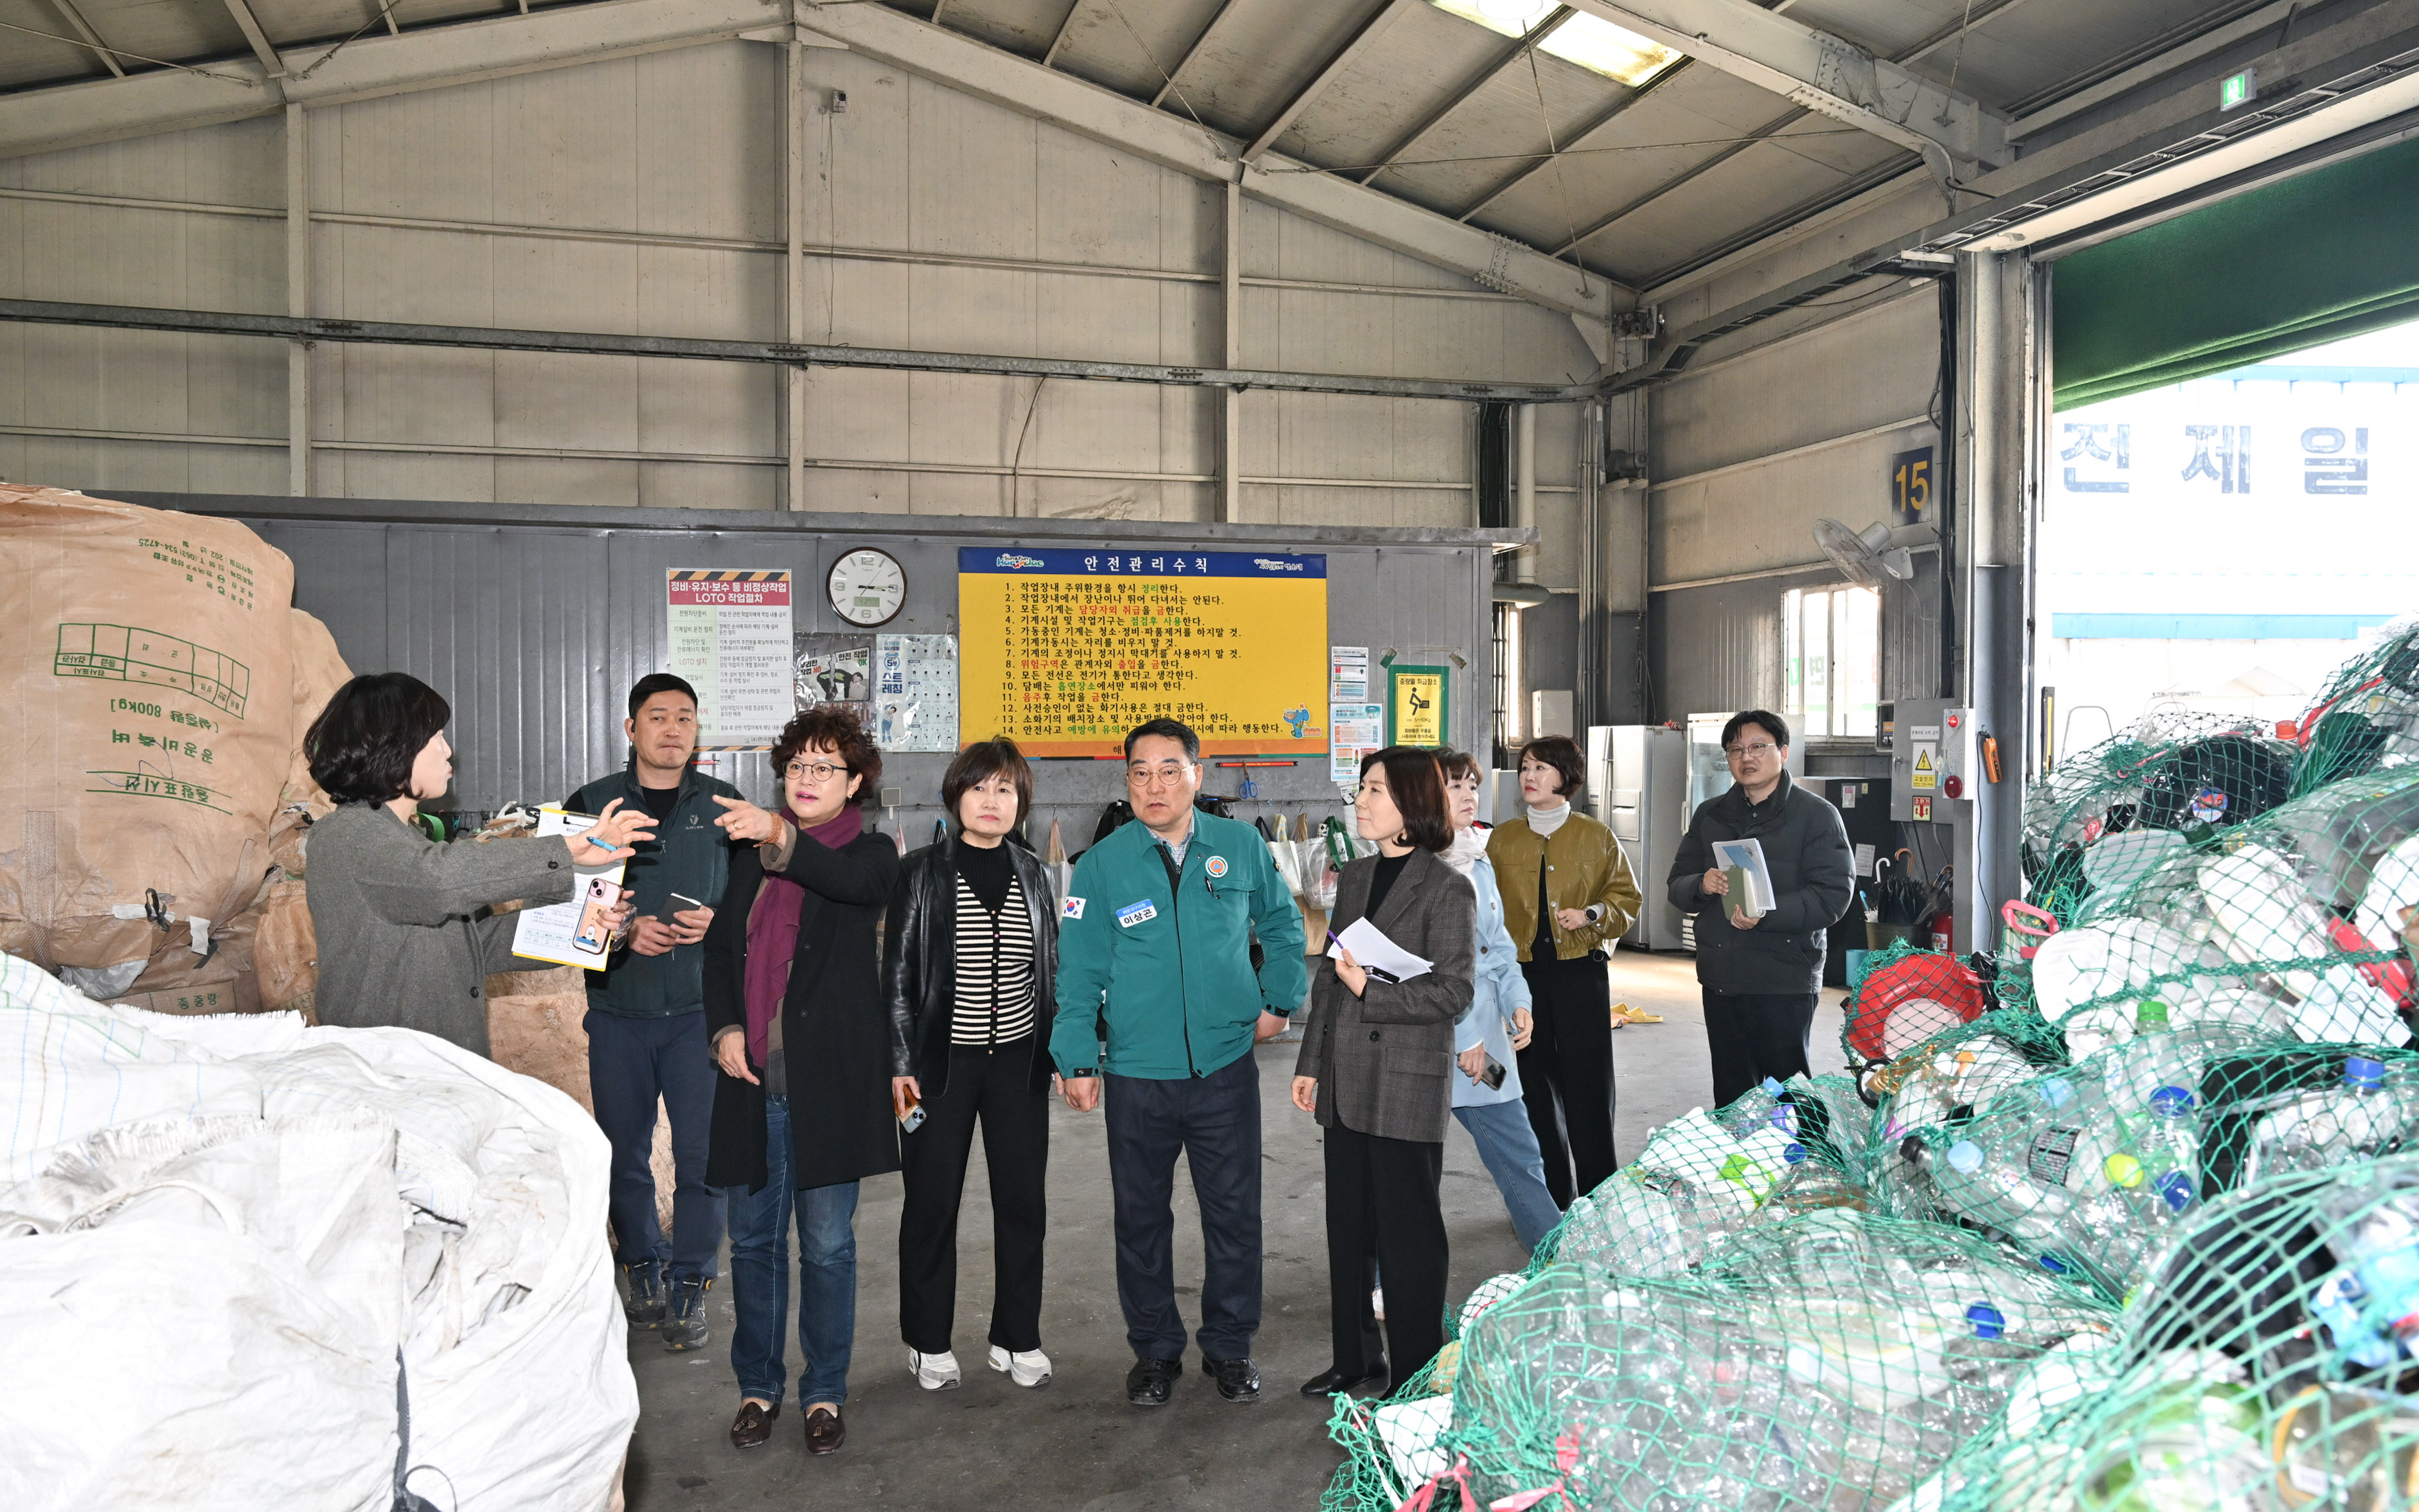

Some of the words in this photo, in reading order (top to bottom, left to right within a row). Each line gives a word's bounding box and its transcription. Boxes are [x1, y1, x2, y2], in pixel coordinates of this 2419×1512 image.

[1895, 459, 1929, 513] 15
[139, 538, 178, 554] 534-4725
[861, 556, 874, 566] 12
[997, 556, 1044, 569] Haeundae
[671, 581, 729, 592] 정비·유지·보수
[732, 582, 741, 592] 등
[744, 582, 787, 592] 비정상작업
[835, 582, 845, 591] 9
[1006, 582, 1014, 591] 1.
[1021, 582, 1059, 593] 작업장내
[1065, 582, 1112, 594] 주위환경을
[1118, 583, 1136, 594] 항시
[1141, 583, 1182, 594] 정리한다.
[695, 593, 726, 603] LOTO
[728, 594, 763, 603] 작업절차
[1005, 593, 1015, 602] 2.
[1021, 592, 1078, 604] 작업장내에서
[1084, 593, 1122, 605] 장난이나
[1127, 594, 1146, 605] 뛰어
[1150, 594, 1186, 605] 다녀서는
[1193, 594, 1224, 605] 안된다.
[862, 609, 871, 618] 6
[1005, 604, 1015, 613] 3.
[1021, 604, 1040, 614] 모든
[1045, 604, 1073, 615] 기계는
[1079, 605, 1117, 615] 담당자외
[1123, 605, 1150, 616] 취급을
[1157, 605, 1188, 616] 금한다.
[1005, 616, 1015, 625] 4.
[1021, 614, 1058, 626] 기계시설
[1064, 615, 1072, 626] 및
[1078, 615, 1125, 627] 작업기구는
[1130, 616, 1158, 627] 점검후
[1164, 616, 1205, 627] 사용한다.
[1005, 627, 1015, 636] 5.
[1021, 626, 1059, 637] 가동중인
[1065, 626, 1093, 637] 기계는
[1197, 627, 1224, 638] 하지말
[1229, 627, 1241, 637] 것.
[1005, 637, 1015, 646] 6.
[1021, 637, 1078, 648] 기계가동시는
[1084, 637, 1112, 648] 자리를
[1118, 637, 1145, 648] 비우지
[1150, 637, 1160, 648] 말
[1165, 637, 1177, 648] 것.
[838, 653, 852, 661] 안전
[853, 650, 868, 659] 작업
[1005, 648, 1015, 657] 7.
[1021, 648, 1049, 659] 기계의
[1055, 648, 1093, 659] 조정이나
[1098, 648, 1125, 659] 정지시
[1130, 648, 1170, 659] 막대기를
[1174, 648, 1211, 659] 사용하지
[1215, 648, 1224, 659] 말
[1229, 648, 1241, 659] 것.
[62, 655, 85, 664] 검사관
[100, 658, 116, 668] 등급
[858, 658, 867, 666] OK
[1005, 659, 1015, 669] 8.
[1021, 659, 1068, 670] 위험구역은
[1074, 659, 1112, 670] 관계자외
[1118, 659, 1145, 670] 출입을
[1152, 659, 1183, 670] 금한다.
[74, 668, 105, 677] 검사표시
[800, 667, 812, 675] 작업
[1005, 671, 1015, 680] 9.
[1021, 670, 1040, 680] 모든
[1046, 670, 1074, 680] 전선은
[1079, 670, 1107, 680] 전기가
[1112, 670, 1151, 681] 통한다고
[1156, 670, 1198, 680] 생각한다.
[882, 672, 902, 682] 스트
[882, 683, 902, 694] 레칭
[1003, 682, 1017, 691] 10.
[1022, 680, 1052, 692] 담배는
[1057, 680, 1125, 692] 흡연장소에서만
[1130, 680, 1158, 691] 피워야
[1163, 680, 1185, 691] 한다.
[1002, 693, 1017, 702] 11.
[1024, 692, 1052, 702] 음주후
[1057, 691, 1085, 703] 작업을
[1092, 691, 1124, 702] 금한다.
[1003, 704, 1017, 713] 12.
[1023, 702, 1071, 714] 사전승인이
[1076, 702, 1093, 713] 없는
[1100, 702, 1148, 713] 화기사용은
[1153, 702, 1171, 713] 절대
[1177, 702, 1208, 713] 금한다.
[1003, 715, 1017, 724] 13.
[1022, 713, 1061, 724] 소화기의
[1067, 713, 1105, 724] 배치장소
[1110, 713, 1119, 724] 및
[1177, 714, 1205, 724] 알아야
[1210, 713, 1233, 724] 한다.
[1003, 725, 1017, 735] 14.
[1022, 724, 1062, 736] 안전사고
[1067, 724, 1096, 735] 예방에
[1219, 724, 1237, 734] 따라
[1242, 724, 1283, 734] 행동한다.
[1123, 909, 1152, 924] 이상곤
